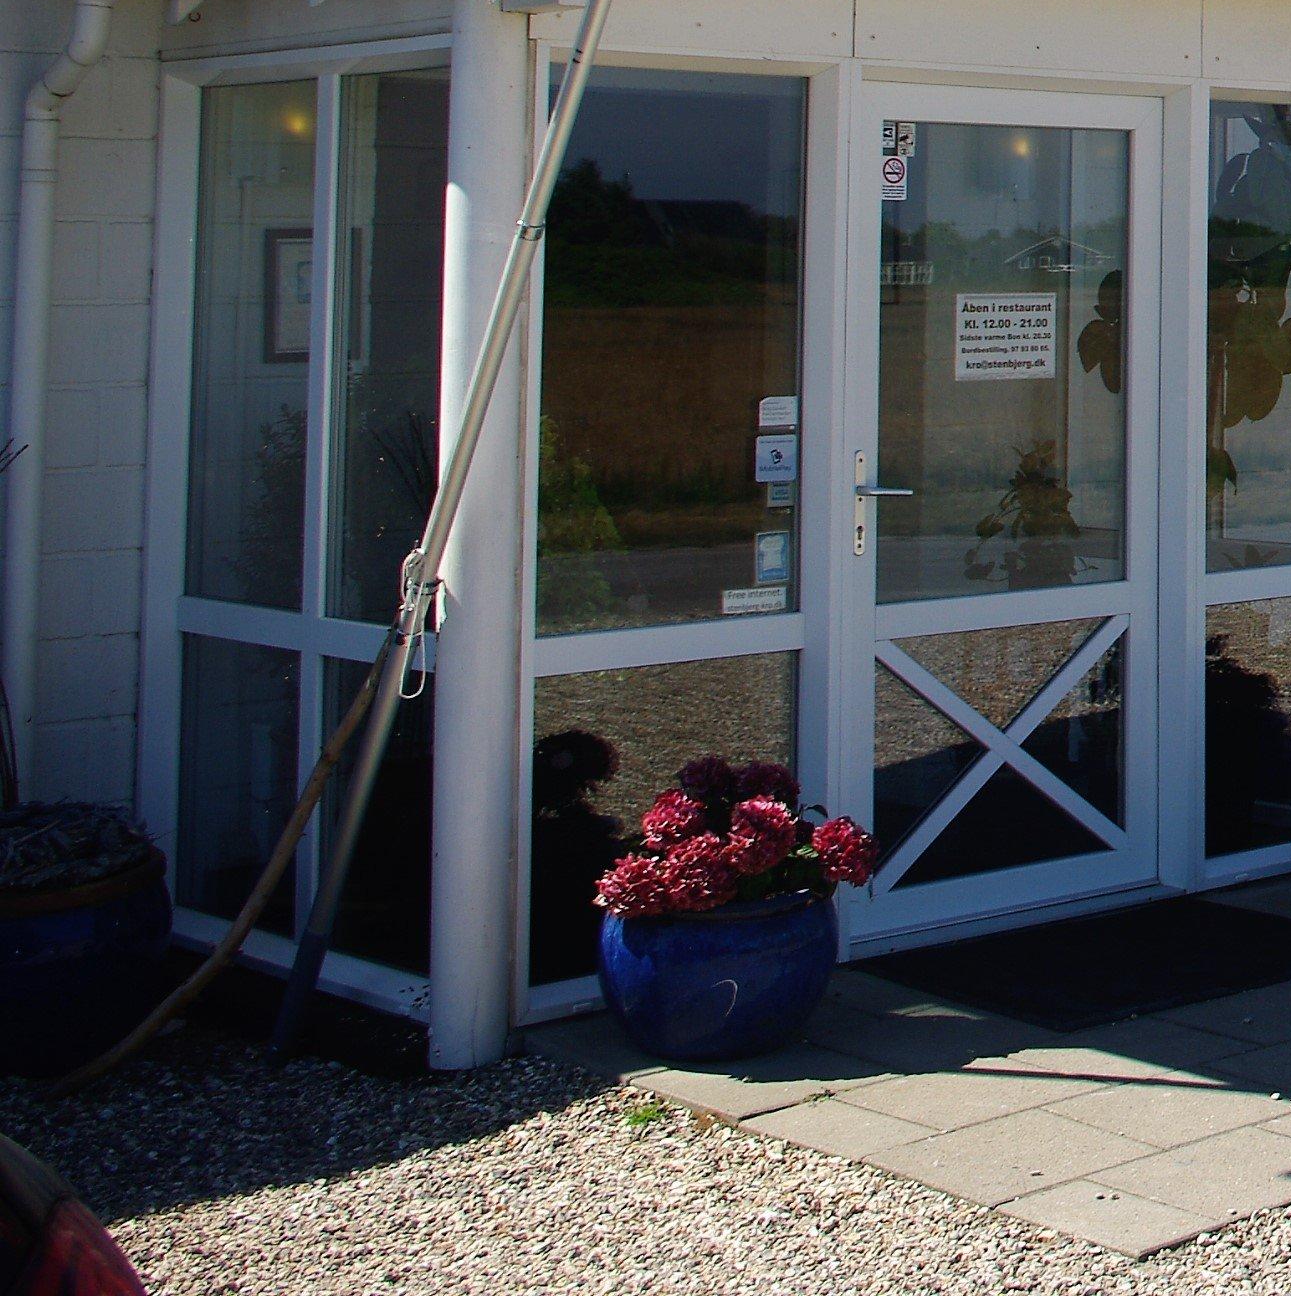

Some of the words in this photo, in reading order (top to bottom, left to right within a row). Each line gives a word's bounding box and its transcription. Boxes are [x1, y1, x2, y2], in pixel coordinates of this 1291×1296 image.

[961, 301, 989, 313] Åben
[998, 302, 1052, 313] restaurant
[964, 319, 979, 329] Kl.
[982, 319, 1011, 329] 12.00
[1019, 318, 1048, 328] 21.00
[727, 591, 746, 600] Free
